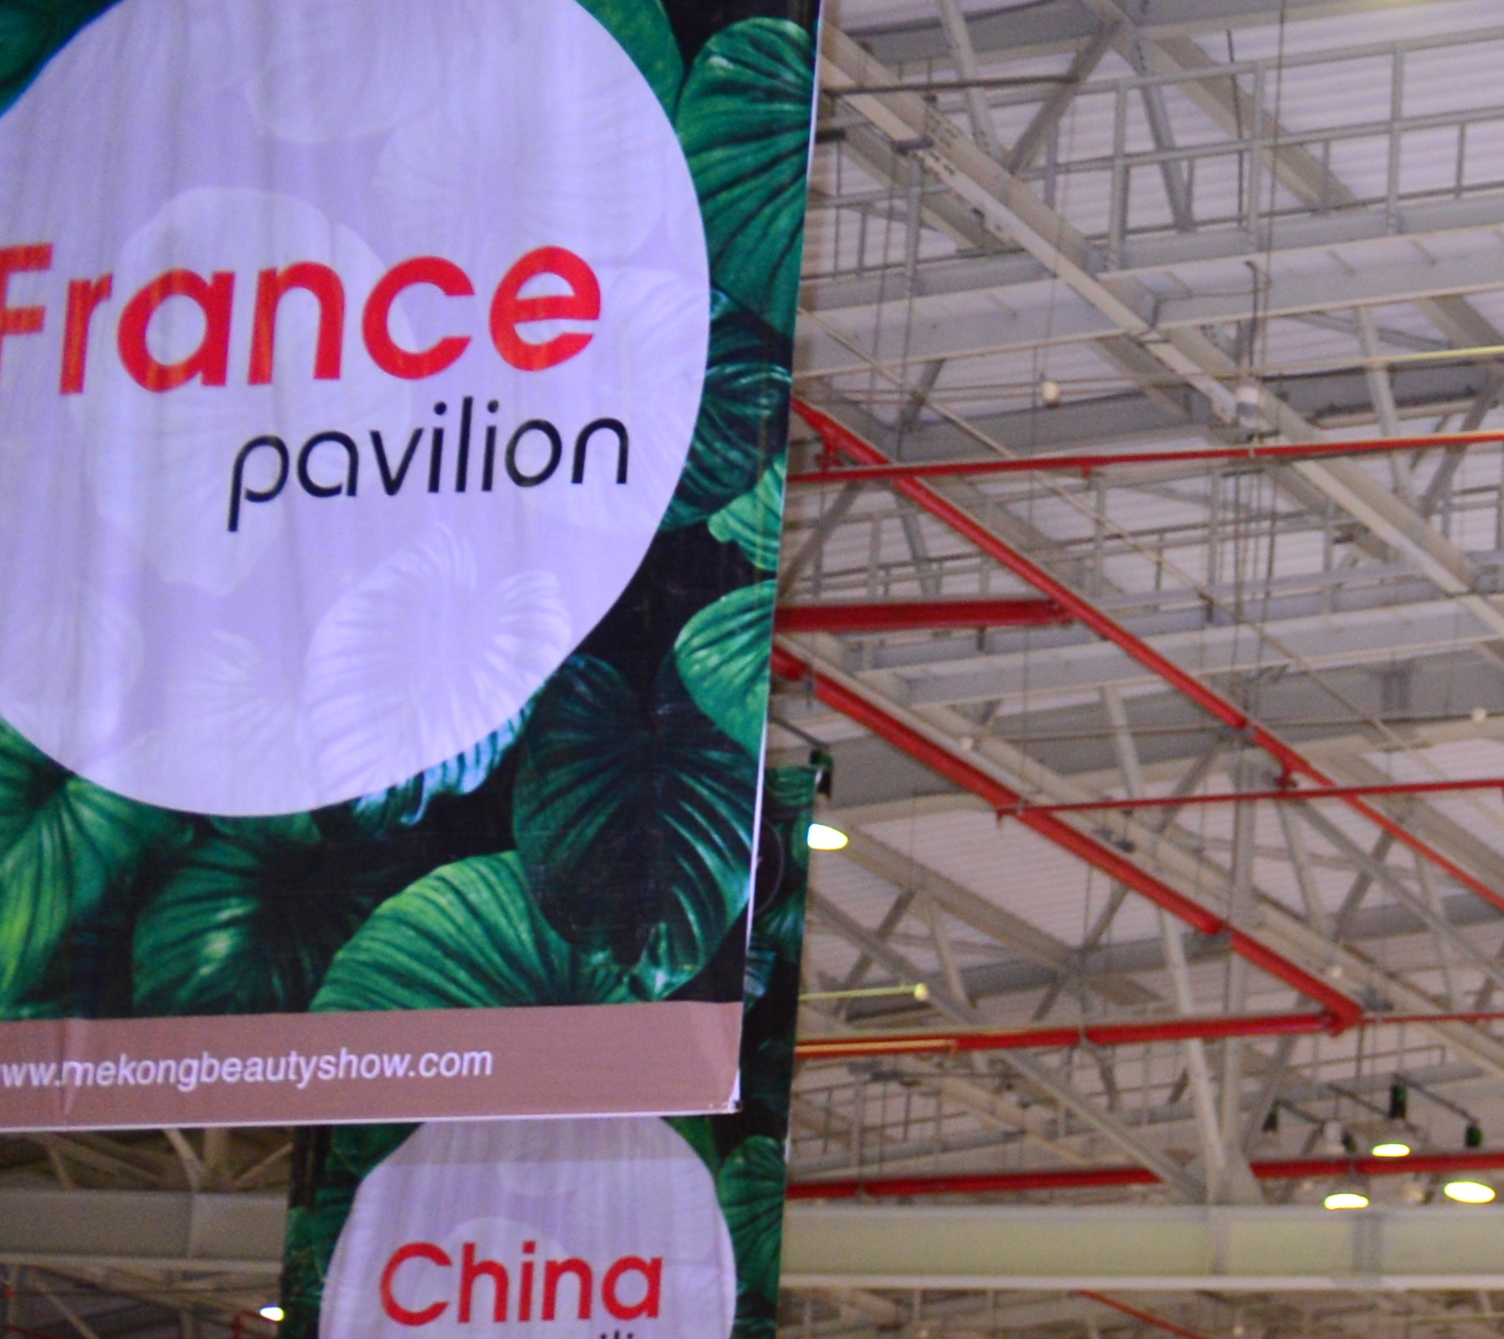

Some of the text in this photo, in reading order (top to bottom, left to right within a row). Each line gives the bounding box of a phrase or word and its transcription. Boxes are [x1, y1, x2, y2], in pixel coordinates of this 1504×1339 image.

[0, 244, 601, 395] France
[228, 396, 629, 532] pavilion
[380, 1241, 663, 1327] China
